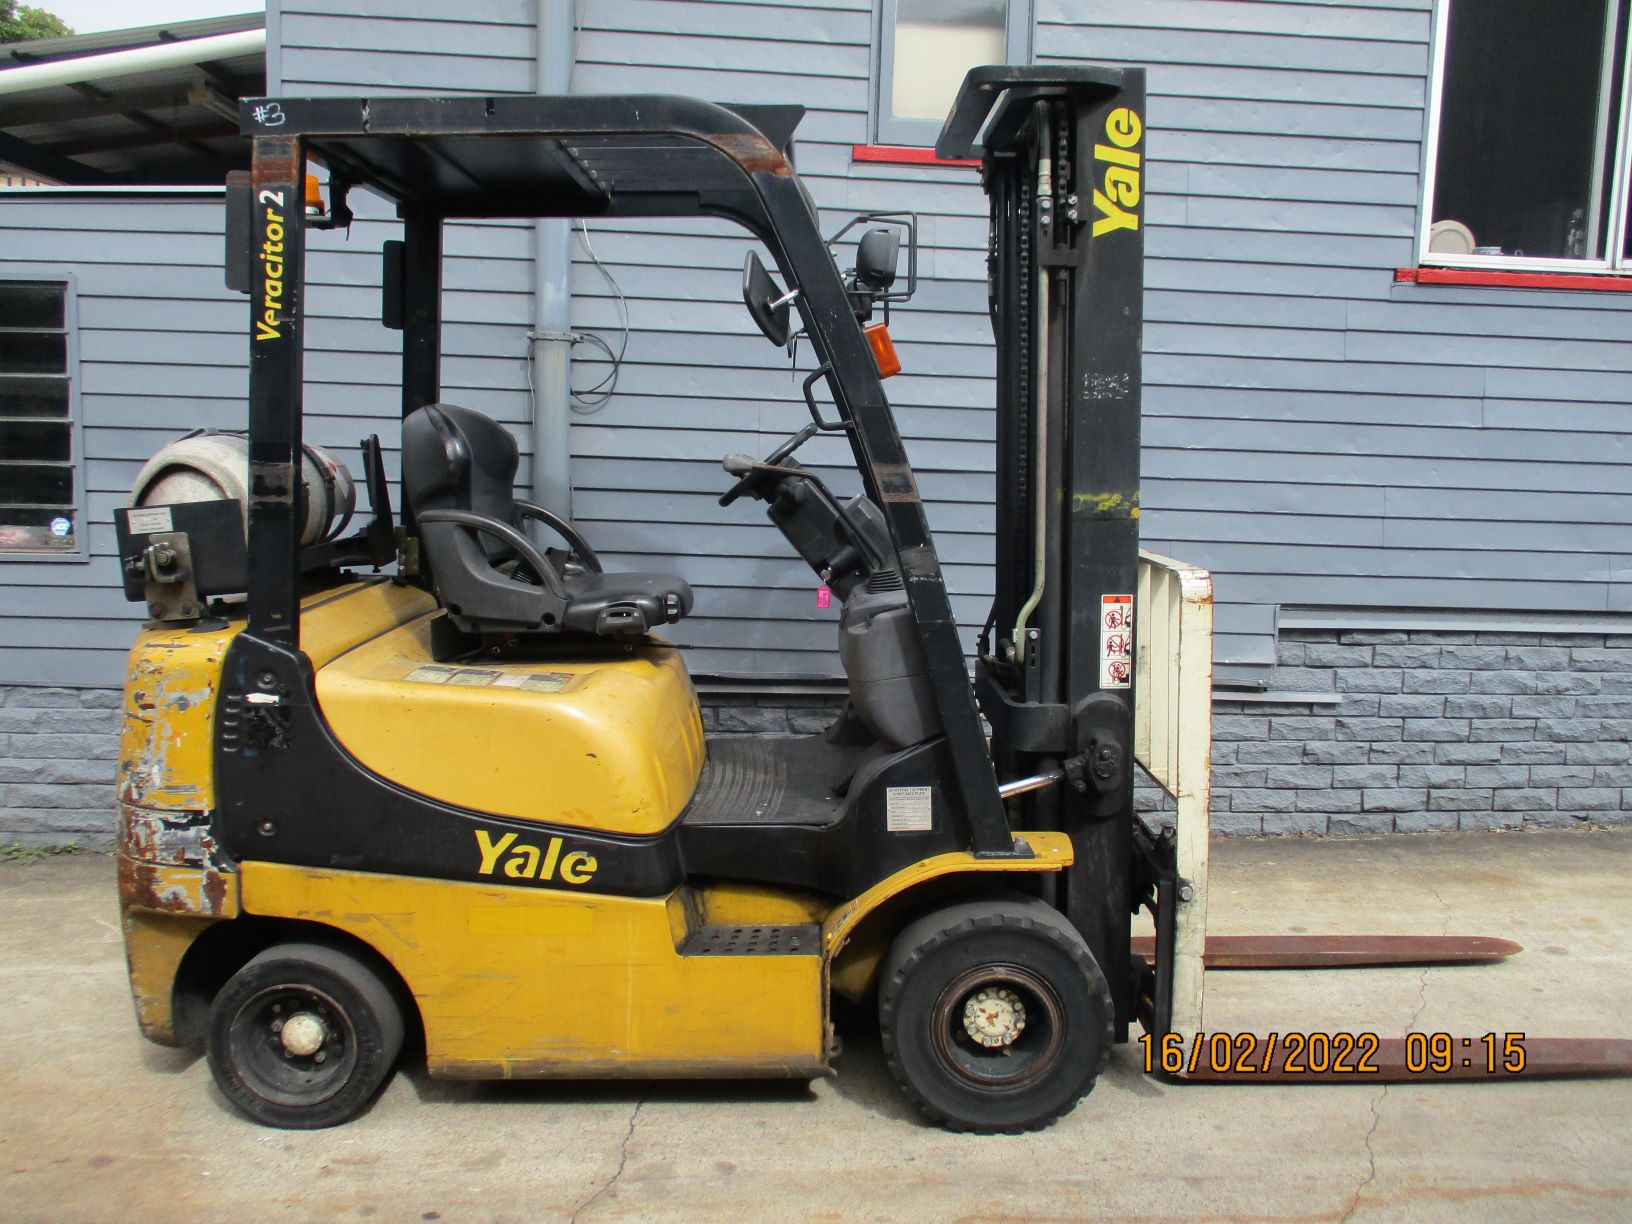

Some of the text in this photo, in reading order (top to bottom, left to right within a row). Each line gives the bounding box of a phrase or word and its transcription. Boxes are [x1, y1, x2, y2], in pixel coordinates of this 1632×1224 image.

[252, 102, 286, 126] #3
[1092, 106, 1142, 238] Yale
[256, 189, 285, 341] Veracitor 2
[474, 829, 598, 885] Yale
